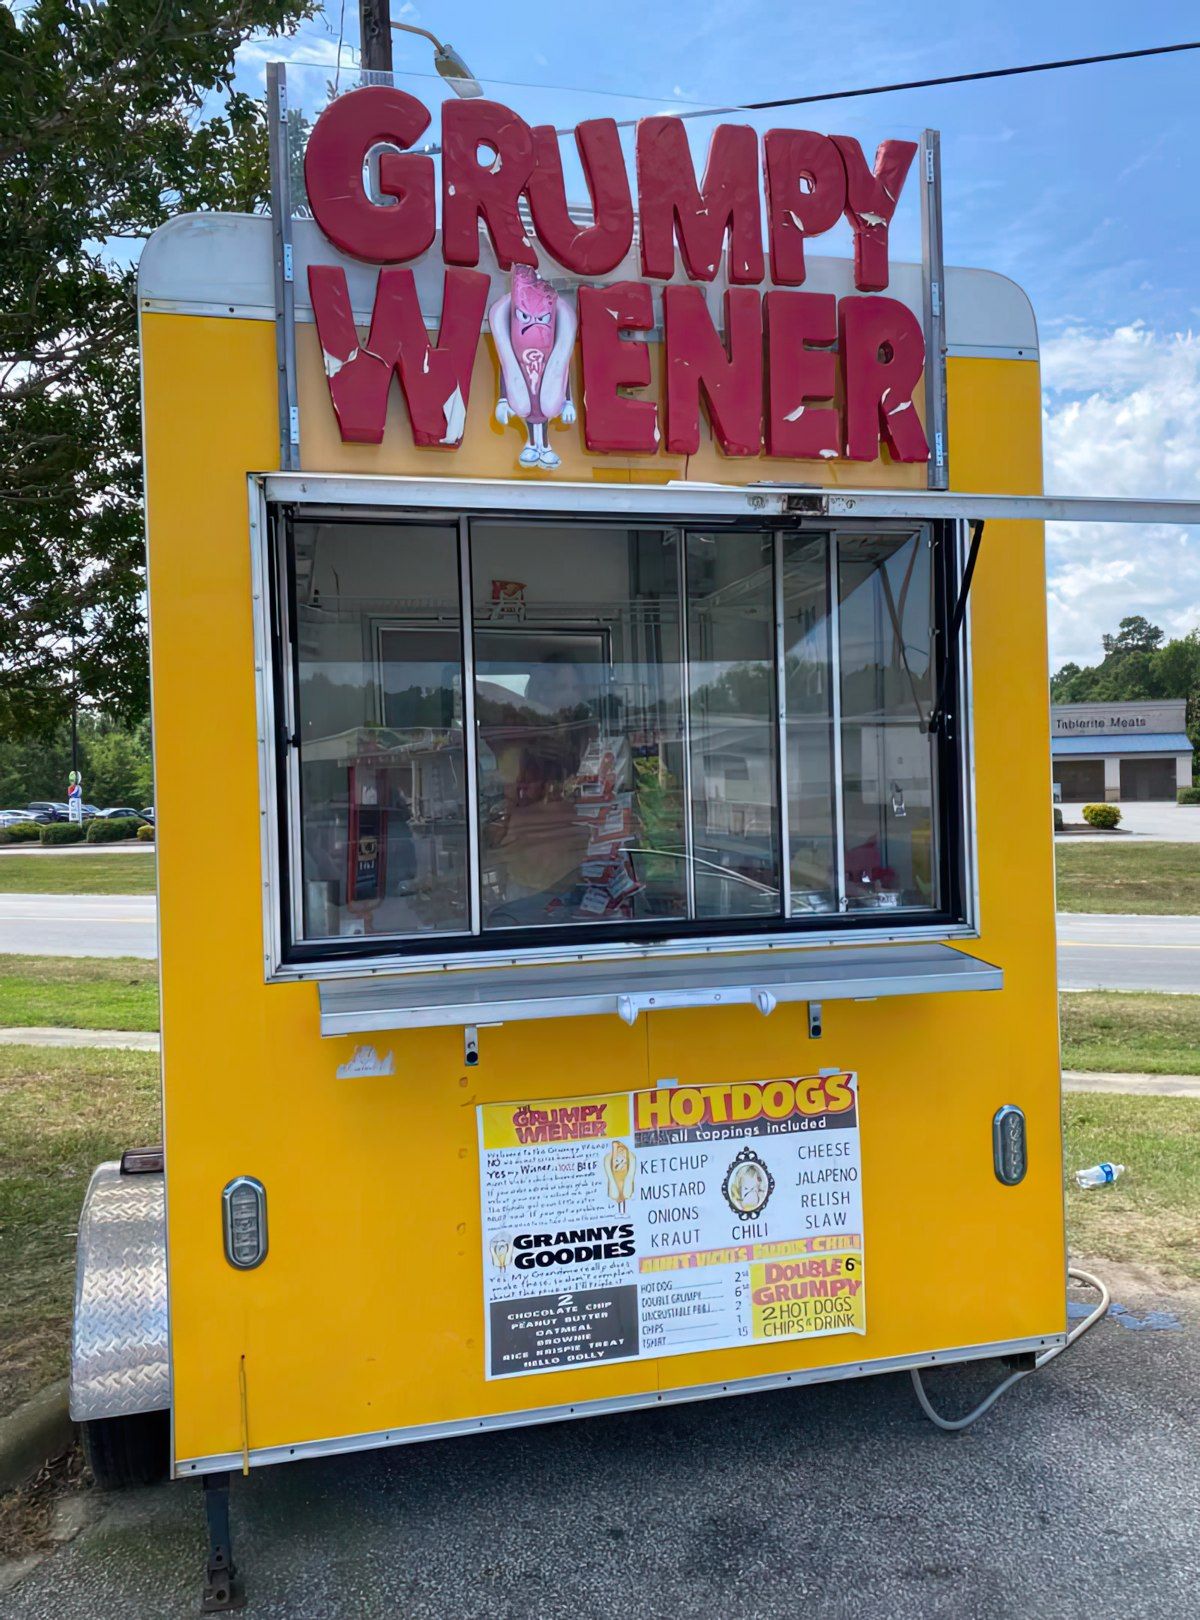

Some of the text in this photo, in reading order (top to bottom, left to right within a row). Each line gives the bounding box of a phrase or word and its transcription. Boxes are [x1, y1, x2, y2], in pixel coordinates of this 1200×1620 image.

[305, 85, 918, 292] GRUMPY
[1110, 717, 1146, 728] Meats
[635, 1073, 854, 1131] HOTDOGS
[512, 1103, 608, 1127] GRUMPY
[515, 1121, 607, 1144] WIENER
[670, 1128, 688, 1143] all
[696, 1126, 760, 1143] toppings
[766, 1117, 827, 1134] included
[797, 1141, 850, 1160] CHEESE
[640, 1154, 709, 1175] KETCHUP
[795, 1167, 858, 1186] JALAPENO
[640, 1181, 706, 1201] MUSTARD
[800, 1191, 851, 1208] RELISH
[647, 1206, 699, 1225] ONIONS
[805, 1212, 848, 1229] SLAW
[513, 1223, 634, 1250] GRANNYS
[650, 1228, 701, 1248] KRAUT
[731, 1222, 769, 1240] CHILI
[514, 1239, 636, 1270] GOODIES
[764, 1257, 856, 1285] DOUBLE 6
[557, 1294, 574, 1307] 2
[752, 1278, 862, 1306] GRUMPY
[507, 1301, 613, 1321] CHOCOLATE CHIP
[735, 1301, 742, 1310] 2
[762, 1296, 852, 1321] 2 HOT DOGS
[511, 1311, 608, 1330] PEANUT BUTTER
[535, 1323, 593, 1337] OATMEAL
[642, 1323, 664, 1335] CHIPS
[763, 1318, 805, 1337] CHIPS
[815, 1314, 855, 1331] DRINK
[502, 1351, 529, 1361] RICE
[589, 1338, 625, 1349] TREAT
[536, 1333, 592, 1347] BROWNIE
[523, 1357, 560, 1368] HELLO
